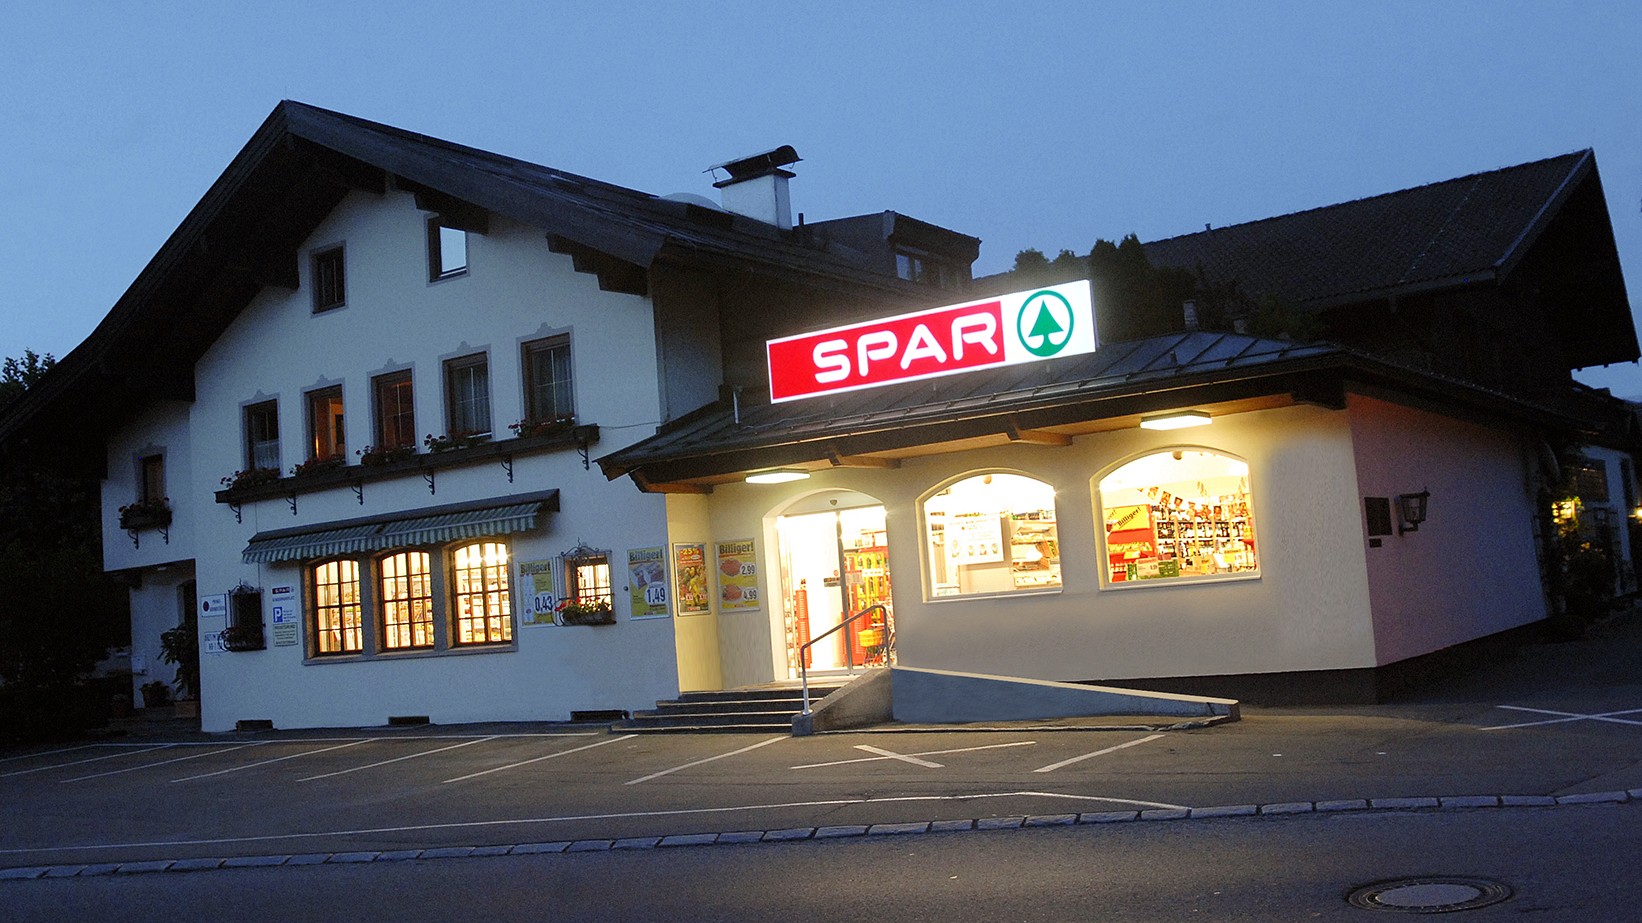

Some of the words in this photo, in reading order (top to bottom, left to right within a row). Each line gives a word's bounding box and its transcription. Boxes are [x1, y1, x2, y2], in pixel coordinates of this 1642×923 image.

[812, 312, 998, 384] SPAR
[1117, 506, 1142, 526] Billiger!
[630, 549, 663, 561] Billiger!
[720, 542, 754, 554] Billiger!
[535, 595, 553, 613] 0,43
[274, 608, 281, 622] P
